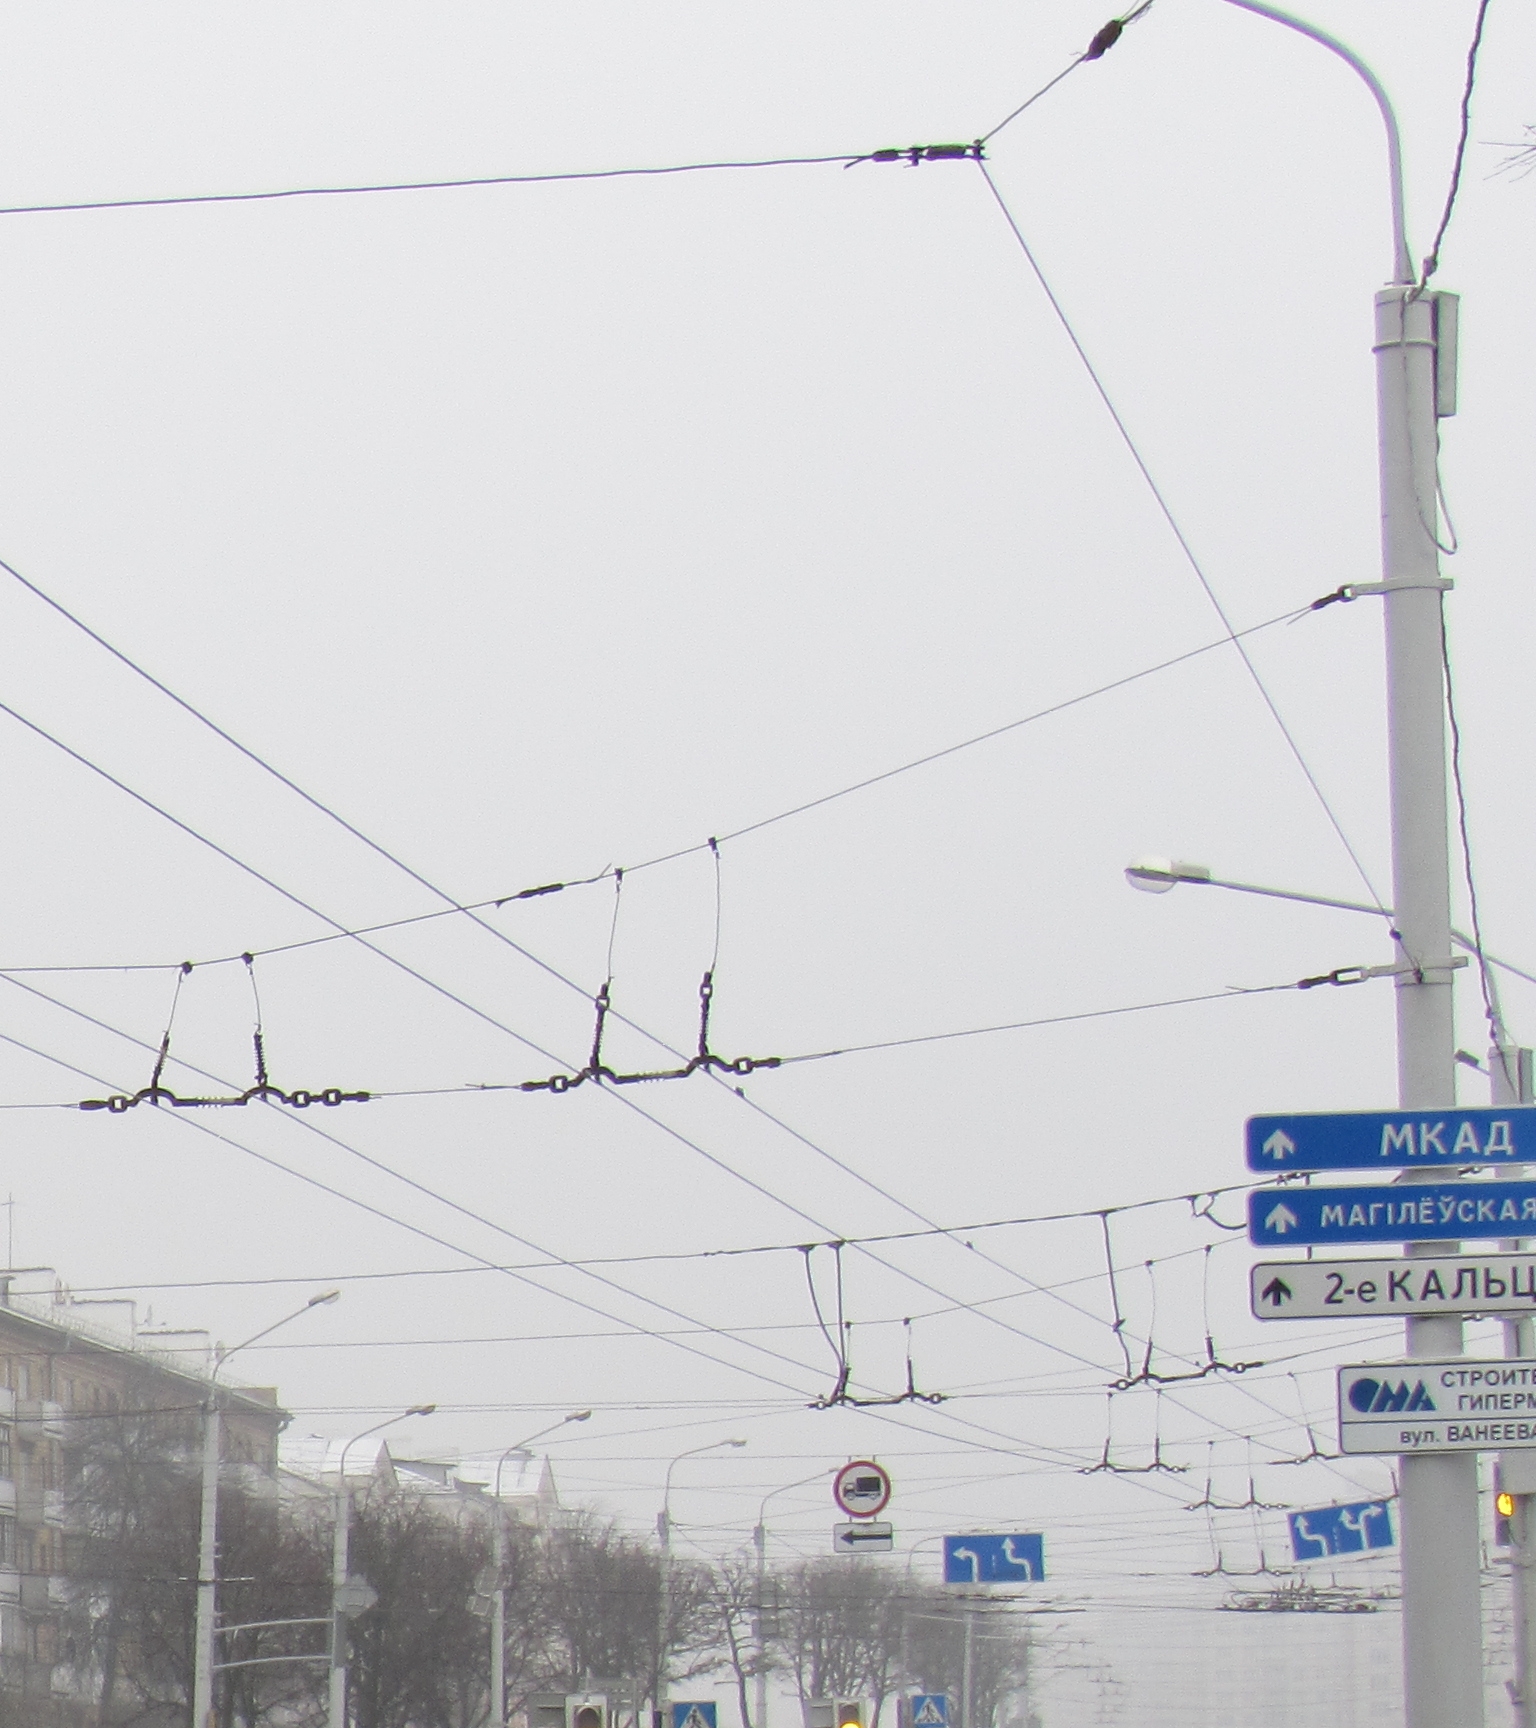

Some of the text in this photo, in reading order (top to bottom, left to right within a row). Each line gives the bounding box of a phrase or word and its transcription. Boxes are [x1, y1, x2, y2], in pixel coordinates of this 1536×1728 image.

[1380, 1120, 1515, 1157] МКАД
[1320, 1195, 1536, 1228] МАГІЛЁЎСКАЯ
[1324, 1265, 1536, 1304] 2-е КАЛЬЦ
[1400, 1430, 1441, 1448] вул.
